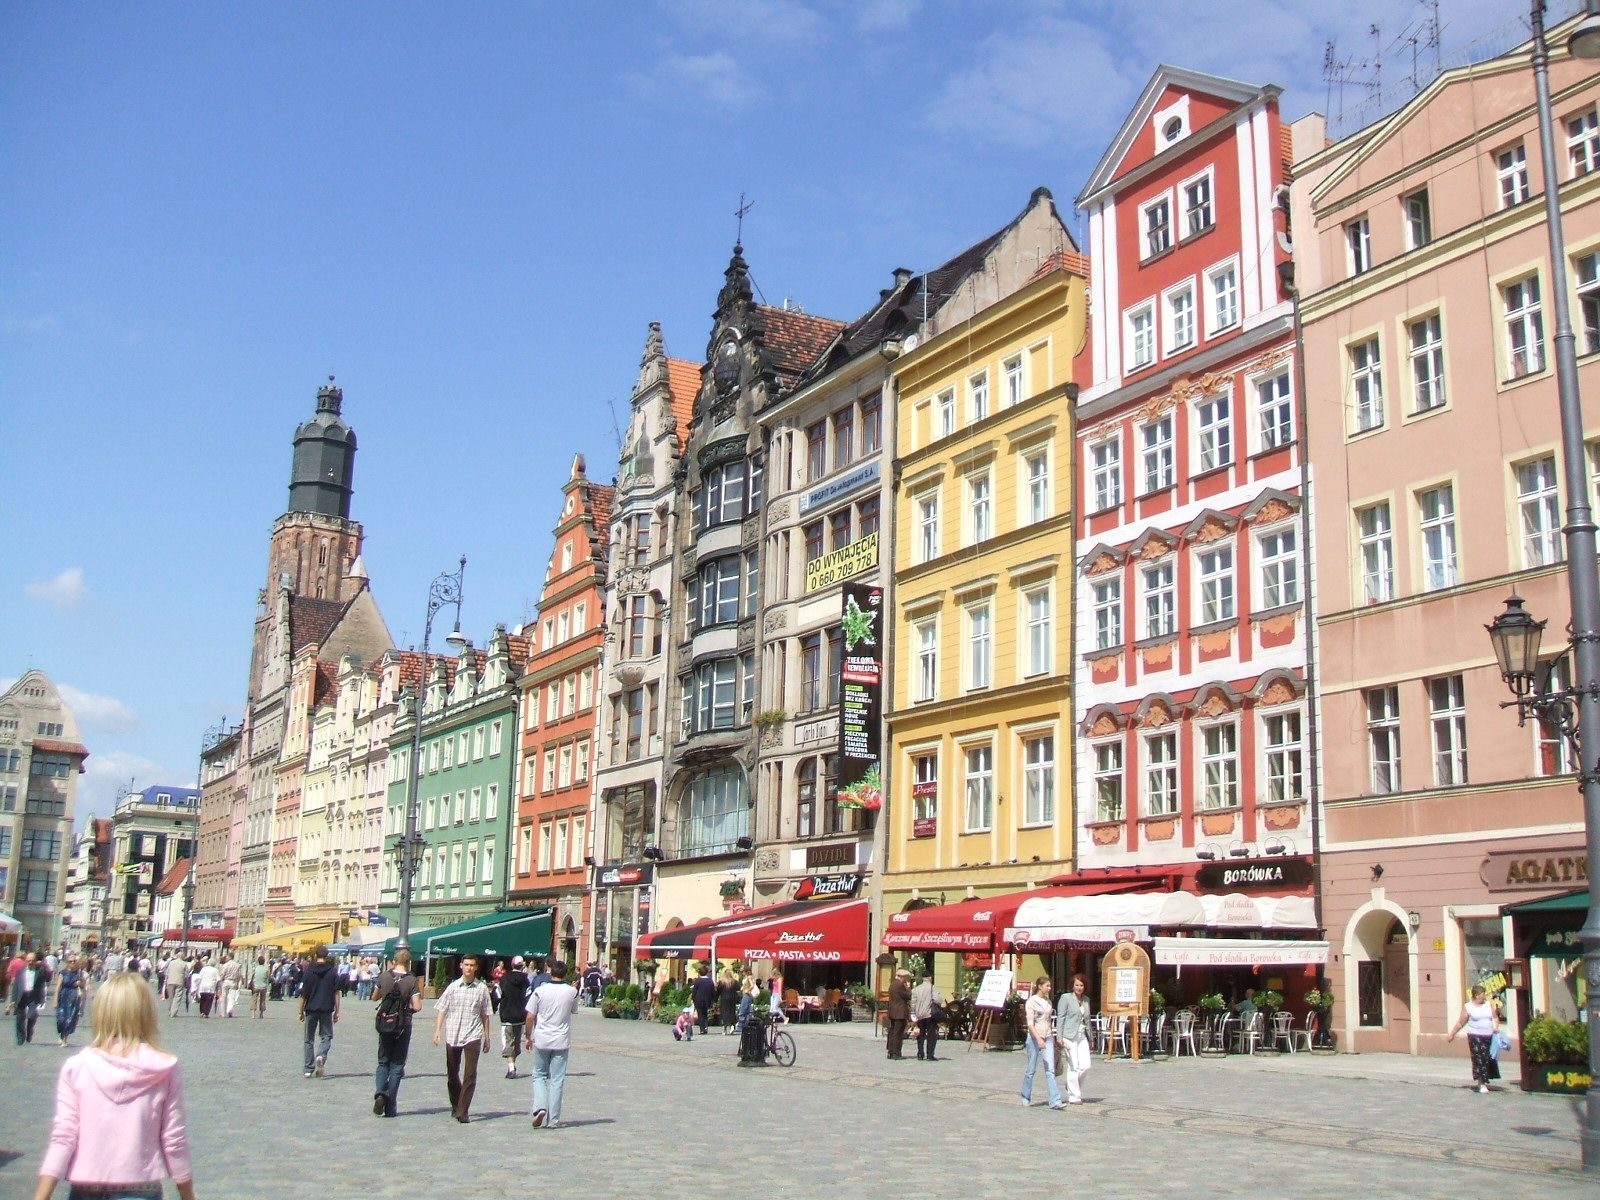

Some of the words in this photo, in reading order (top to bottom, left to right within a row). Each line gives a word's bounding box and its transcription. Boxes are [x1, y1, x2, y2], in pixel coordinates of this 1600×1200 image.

[810, 486, 829, 503] PROFIT
[808, 558, 821, 576] DO
[823, 534, 877, 569] WYNAJĘCIA
[811, 576, 817, 590] 0
[818, 569, 835, 587] 660
[837, 561, 853, 579] 709
[856, 552, 872, 571] 778
[812, 848, 849, 864] DAVIDE
[1223, 865, 1283, 885] BORÓWKA
[812, 876, 837, 895] Pizza
[837, 874, 859, 892] Hut
[779, 931, 804, 942] Pizza
[804, 932, 824, 942] Hut
[909, 932, 923, 944] pod
[743, 949, 770, 958] PIZZA
[778, 950, 805, 959] PASTA
[812, 951, 841, 960] SALAD
[1209, 953, 1225, 963] Pod
